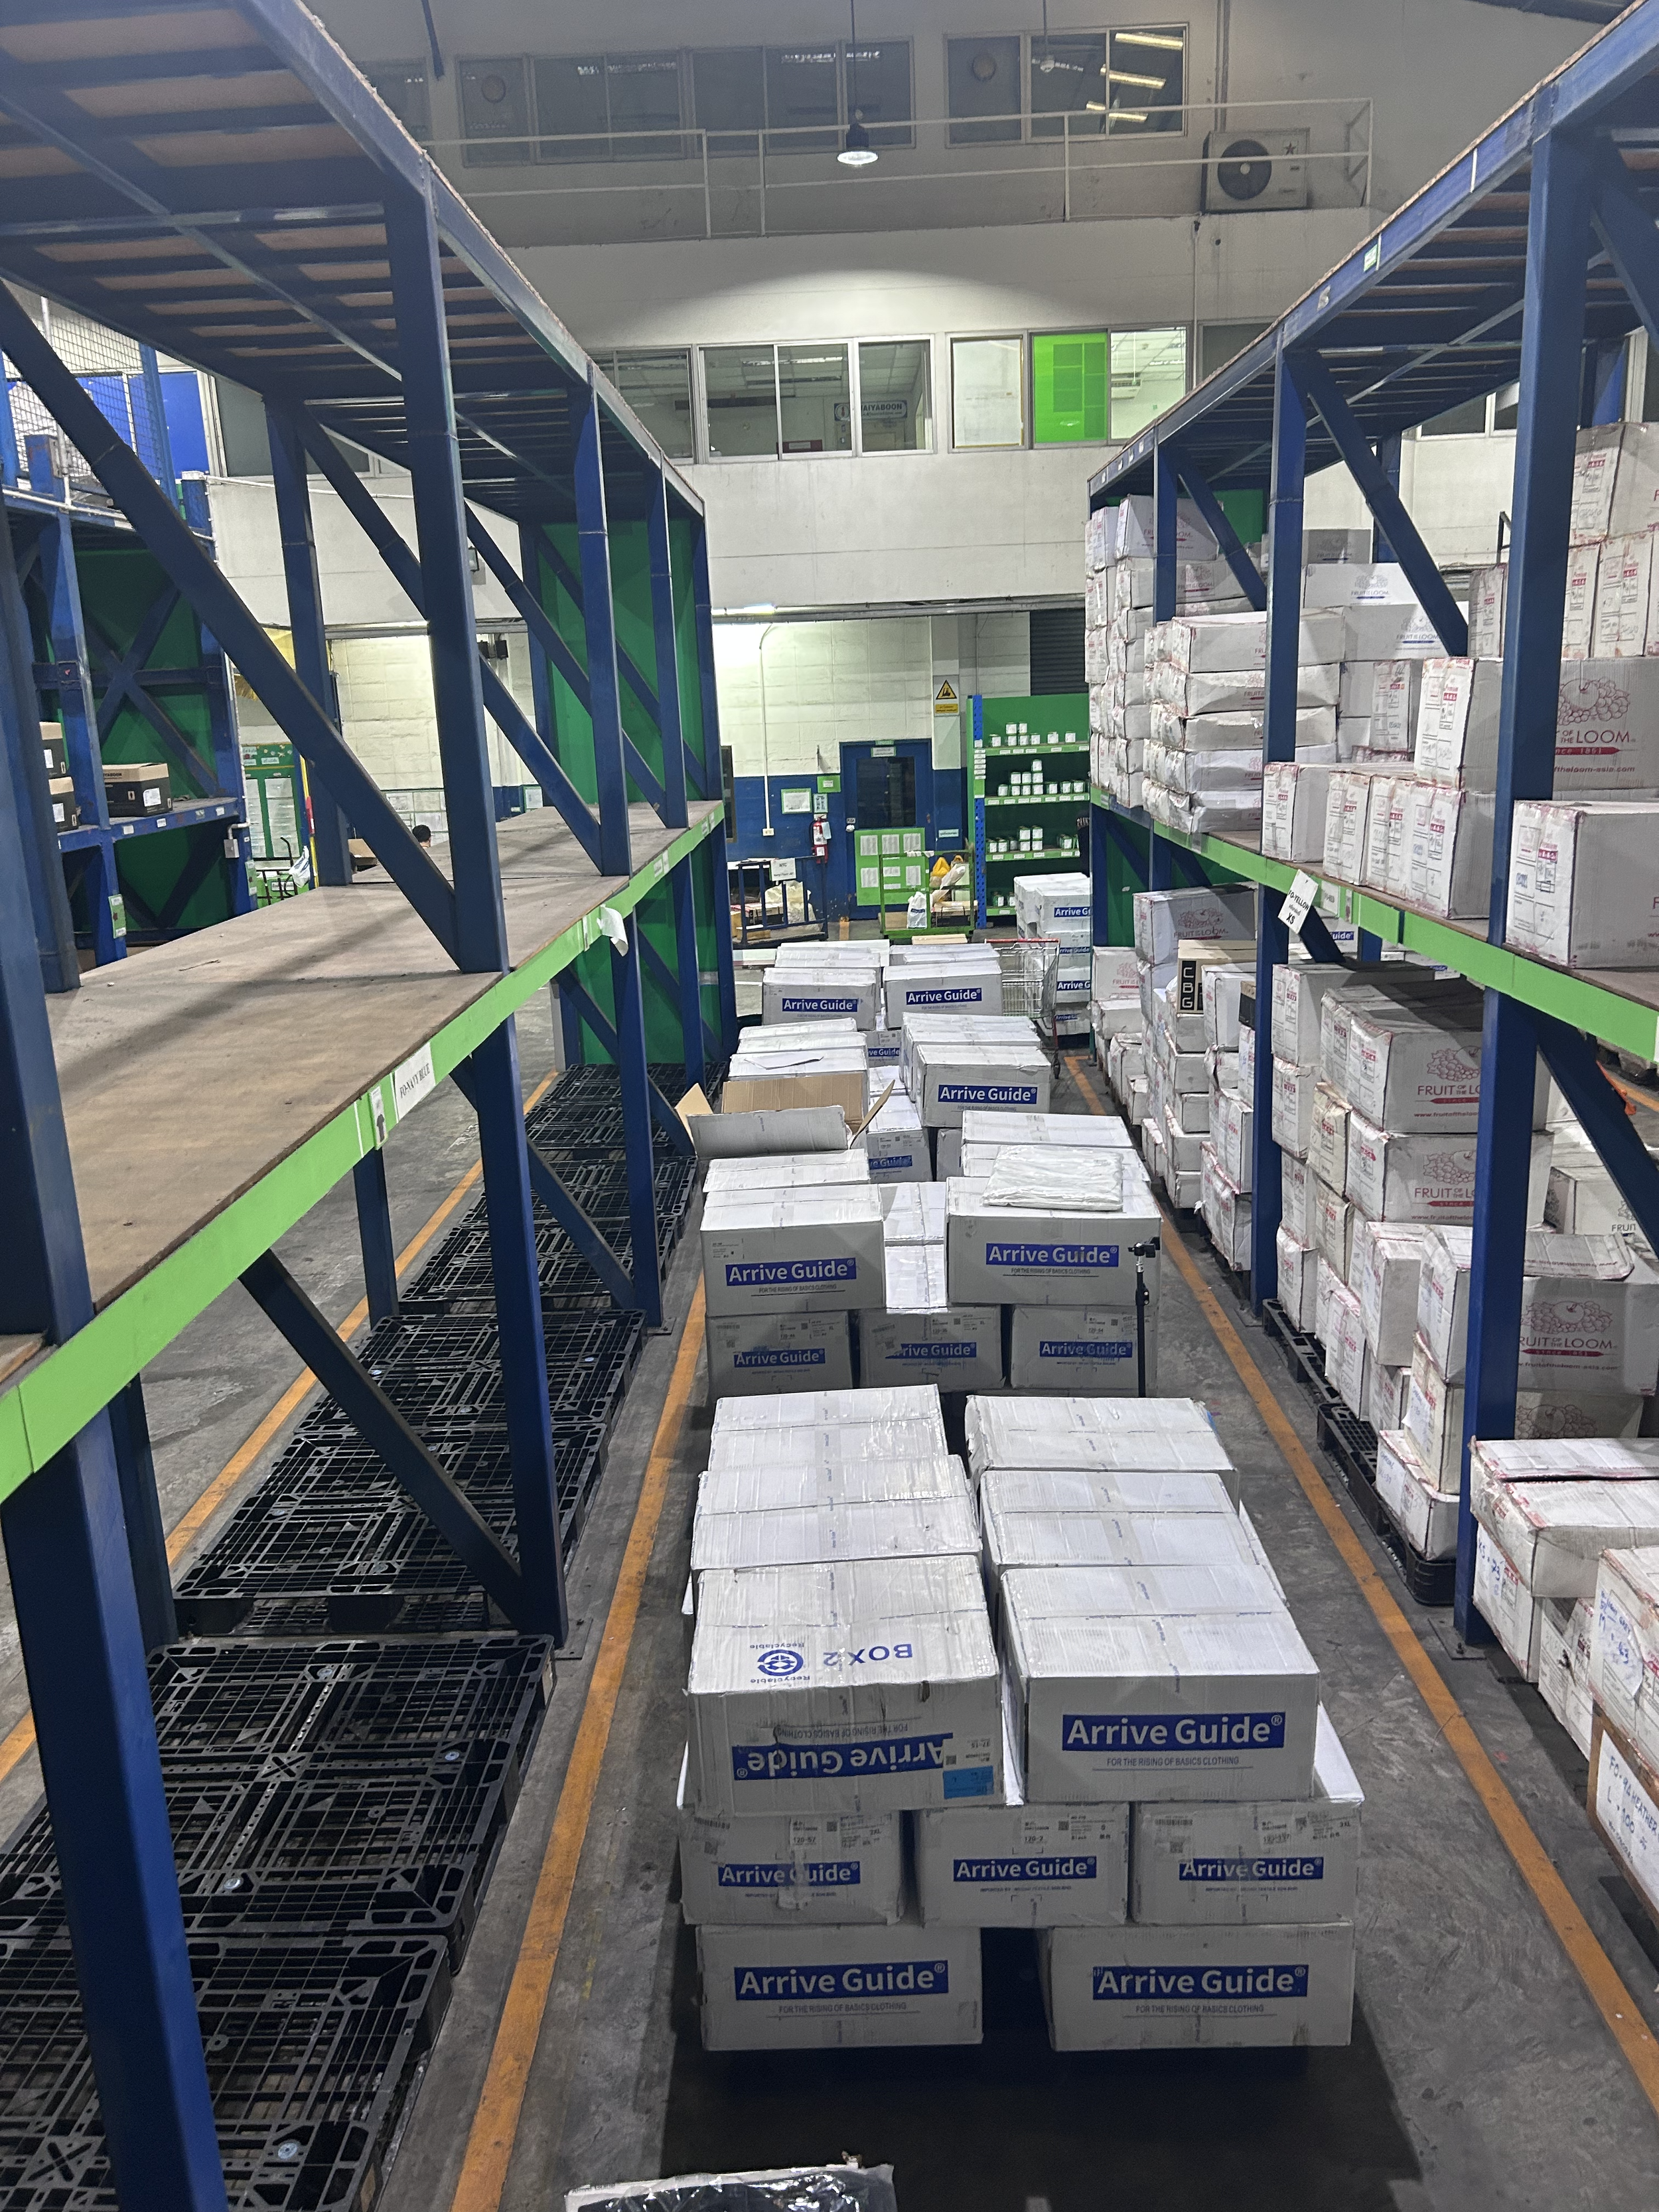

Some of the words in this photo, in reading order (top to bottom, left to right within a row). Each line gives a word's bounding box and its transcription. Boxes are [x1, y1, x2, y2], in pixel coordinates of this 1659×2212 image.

[1577, 730, 1630, 743] LOOM
[1055, 907, 1081, 916] Arrive
[1286, 913, 1295, 924] XS
[1058, 980, 1083, 990] Arrive
[908, 990, 942, 1004] Arrive
[784, 999, 818, 1011] Arrive
[940, 1087, 985, 1100] Arrive
[1417, 1085, 1456, 1096] FRUIT
[1415, 1188, 1452, 1199] FRUIT
[989, 1246, 1049, 1263] Arrive
[729, 1266, 788, 1283] Arrive
[1042, 1343, 1082, 1355] Arrive
[1565, 1338, 1613, 1349] LOOM
[900, 1345, 928, 1357] rrive
[737, 1353, 777, 1365] Arrive
[750, 1643, 805, 1651] Recyclable
[823, 1651, 837, 1667] 2
[848, 1643, 914, 1666] BOX
[751, 1674, 810, 1684] Recyclable
[1067, 1718, 1168, 1745] Arrive
[851, 1741, 944, 1771] Arrive
[1107, 1757, 1122, 1766] FOR
[1123, 1757, 1137, 1766] THE
[1138, 1757, 1163, 1766] RISING
[1165, 1757, 1174, 1766] OF
[1175, 1757, 1202, 1765] BASICS
[1203, 1756, 1239, 1765] CLOTHING
[721, 1866, 784, 1883] Arrive
[956, 1860, 1021, 1878] Arrive
[1182, 1859, 1248, 1878] Arrive
[739, 1968, 835, 1994] Arrive
[1098, 1968, 1194, 1994] Arrive
